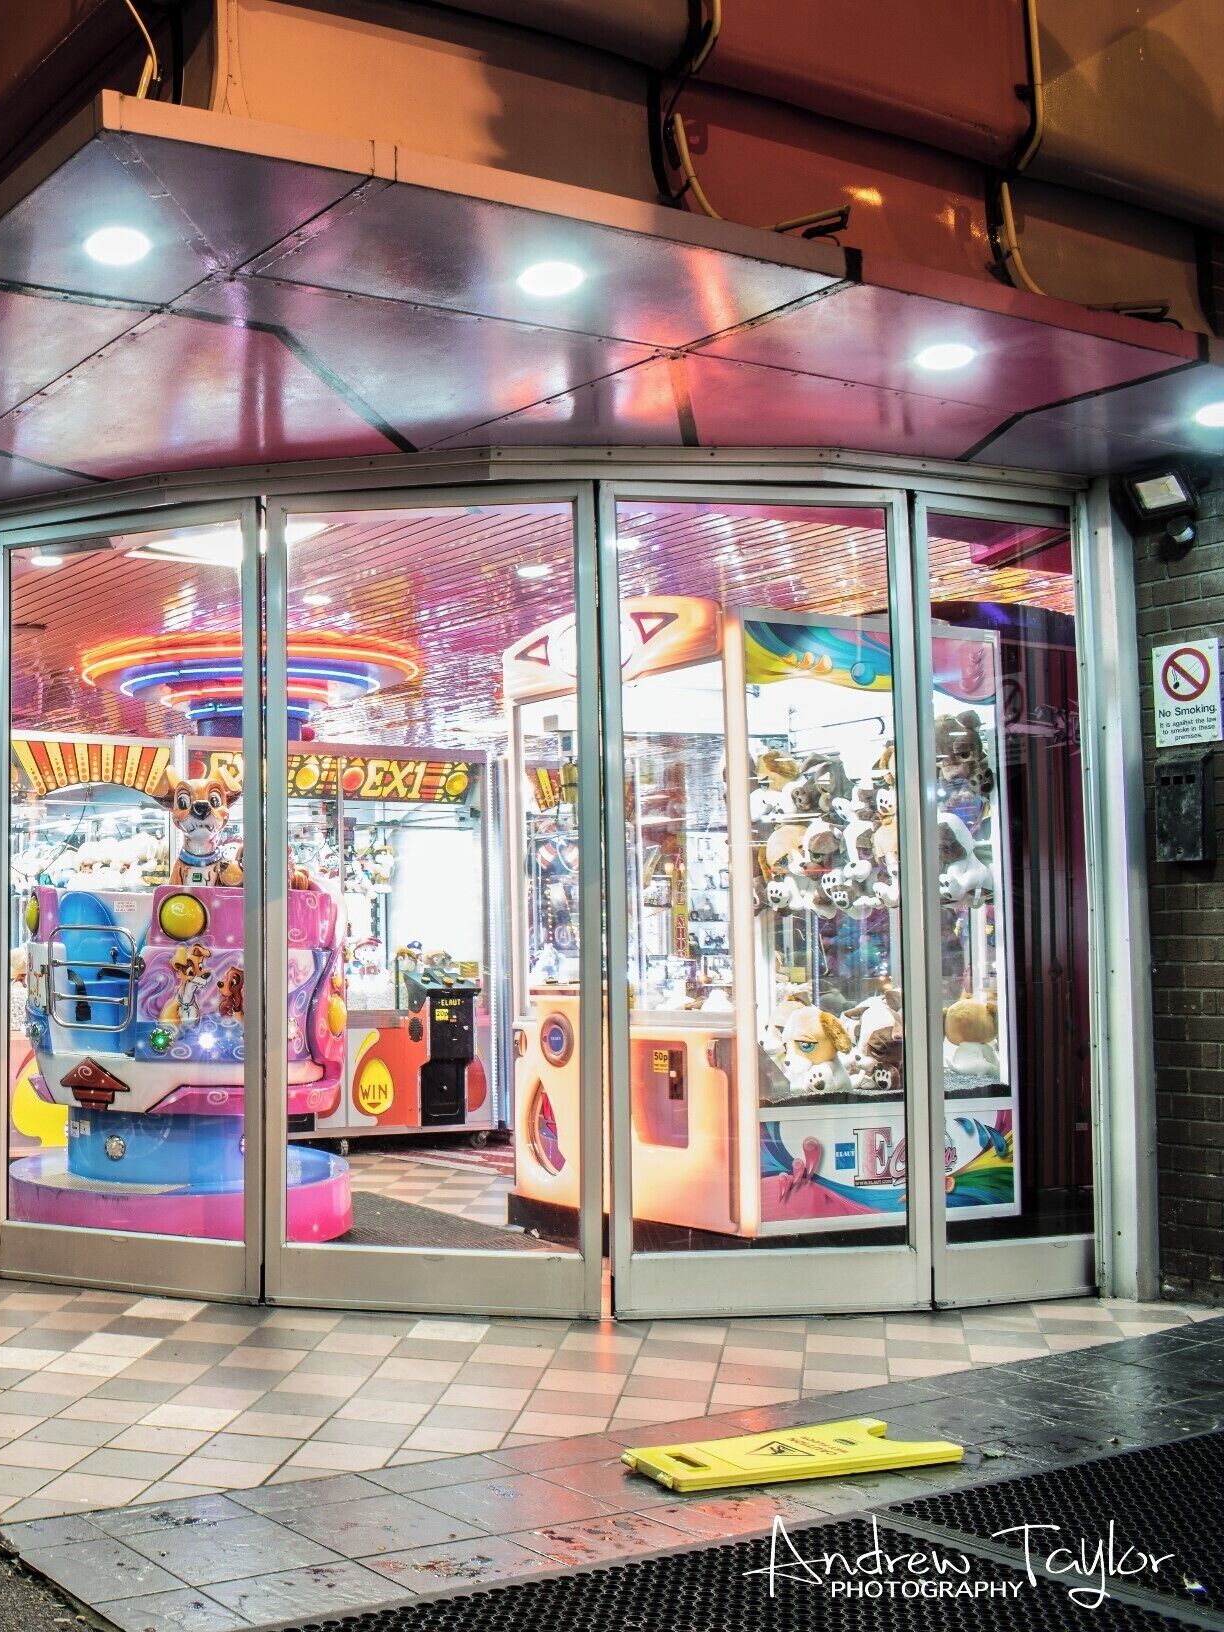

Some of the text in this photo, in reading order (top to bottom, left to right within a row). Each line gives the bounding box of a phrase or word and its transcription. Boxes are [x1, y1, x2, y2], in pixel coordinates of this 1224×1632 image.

[1158, 709, 1171, 718] No
[1173, 719, 1193, 727] against
[654, 1052, 667, 1062] 50p
[360, 1084, 387, 1100] WIN
